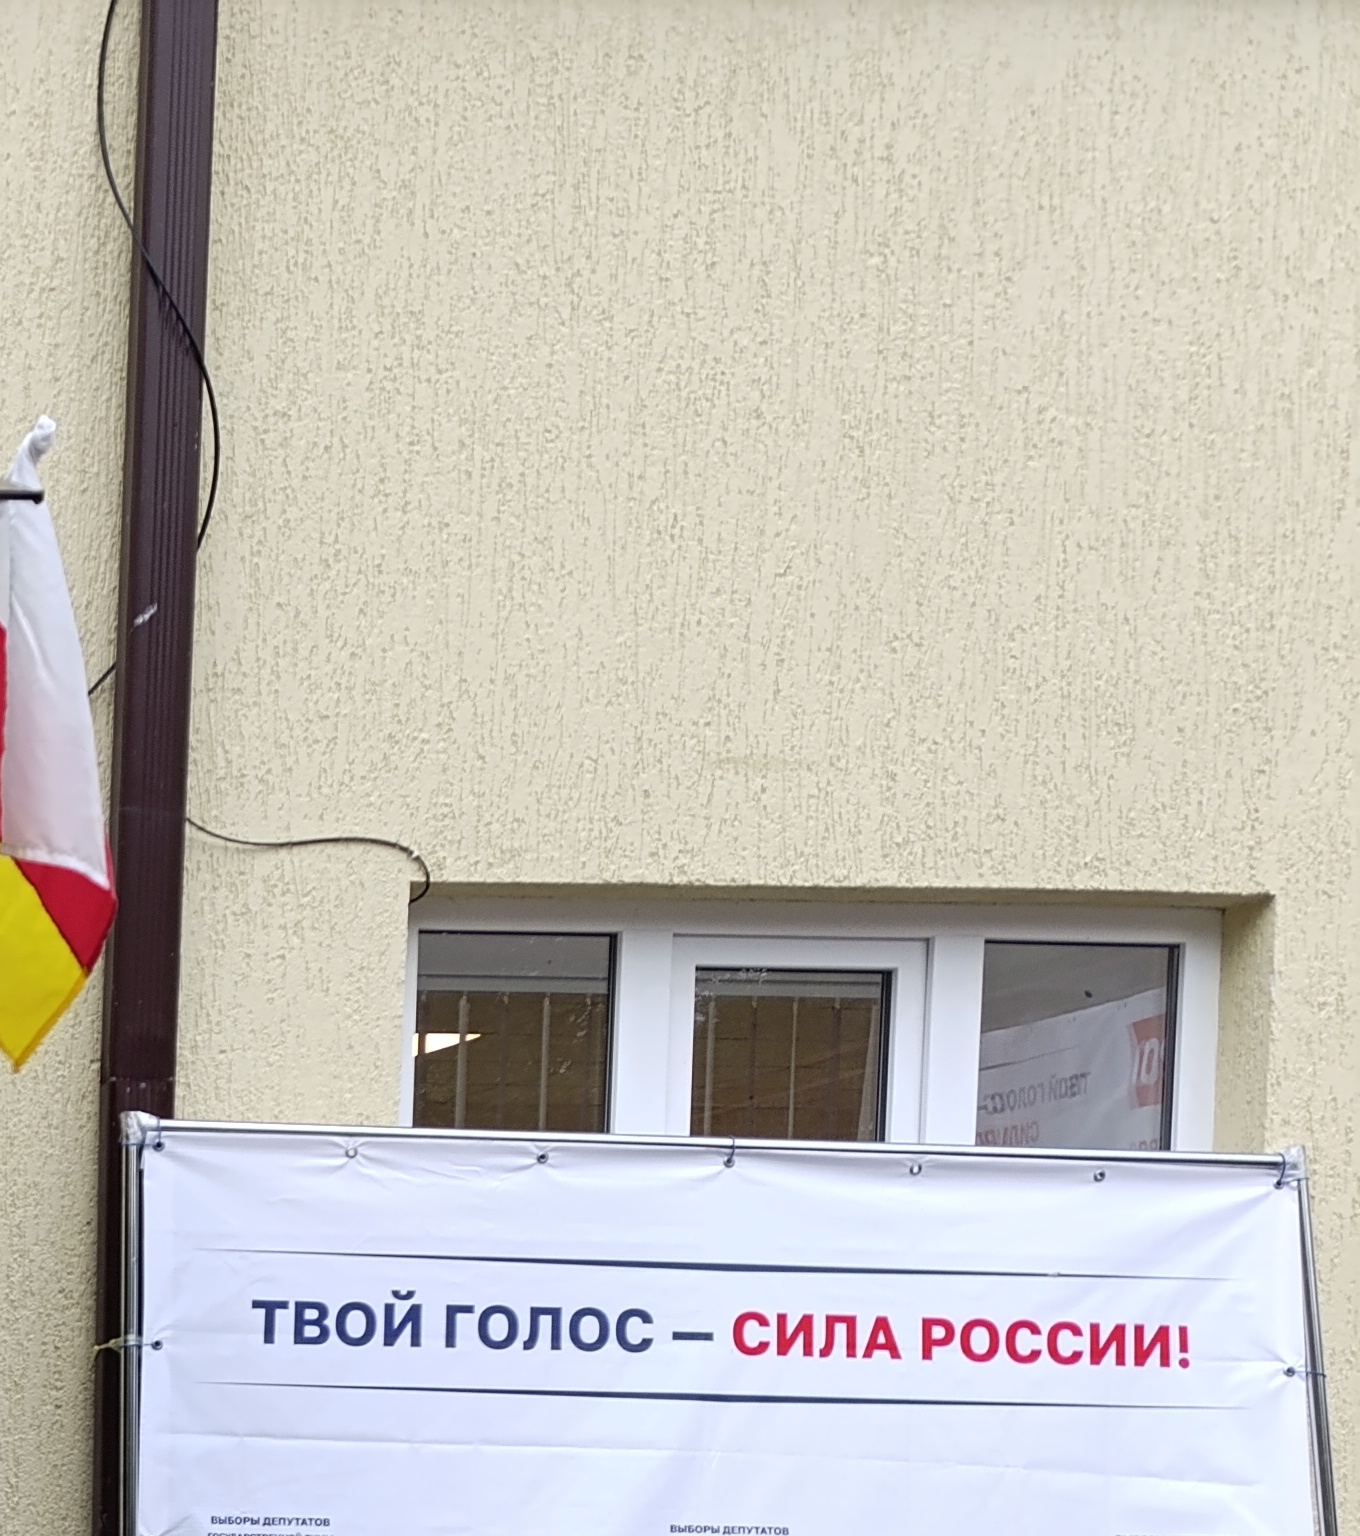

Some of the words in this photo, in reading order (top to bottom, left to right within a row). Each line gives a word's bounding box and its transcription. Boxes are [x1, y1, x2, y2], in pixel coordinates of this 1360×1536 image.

[252, 1290, 422, 1347] ТВОЙ
[445, 1305, 653, 1353] ГОЛОС
[733, 1312, 901, 1359] СИЛА
[922, 1318, 1189, 1368] РОССИИ!
[211, 1516, 260, 1525] ВЫБОРЫ
[262, 1517, 330, 1526] ДЕПУТАТОВ
